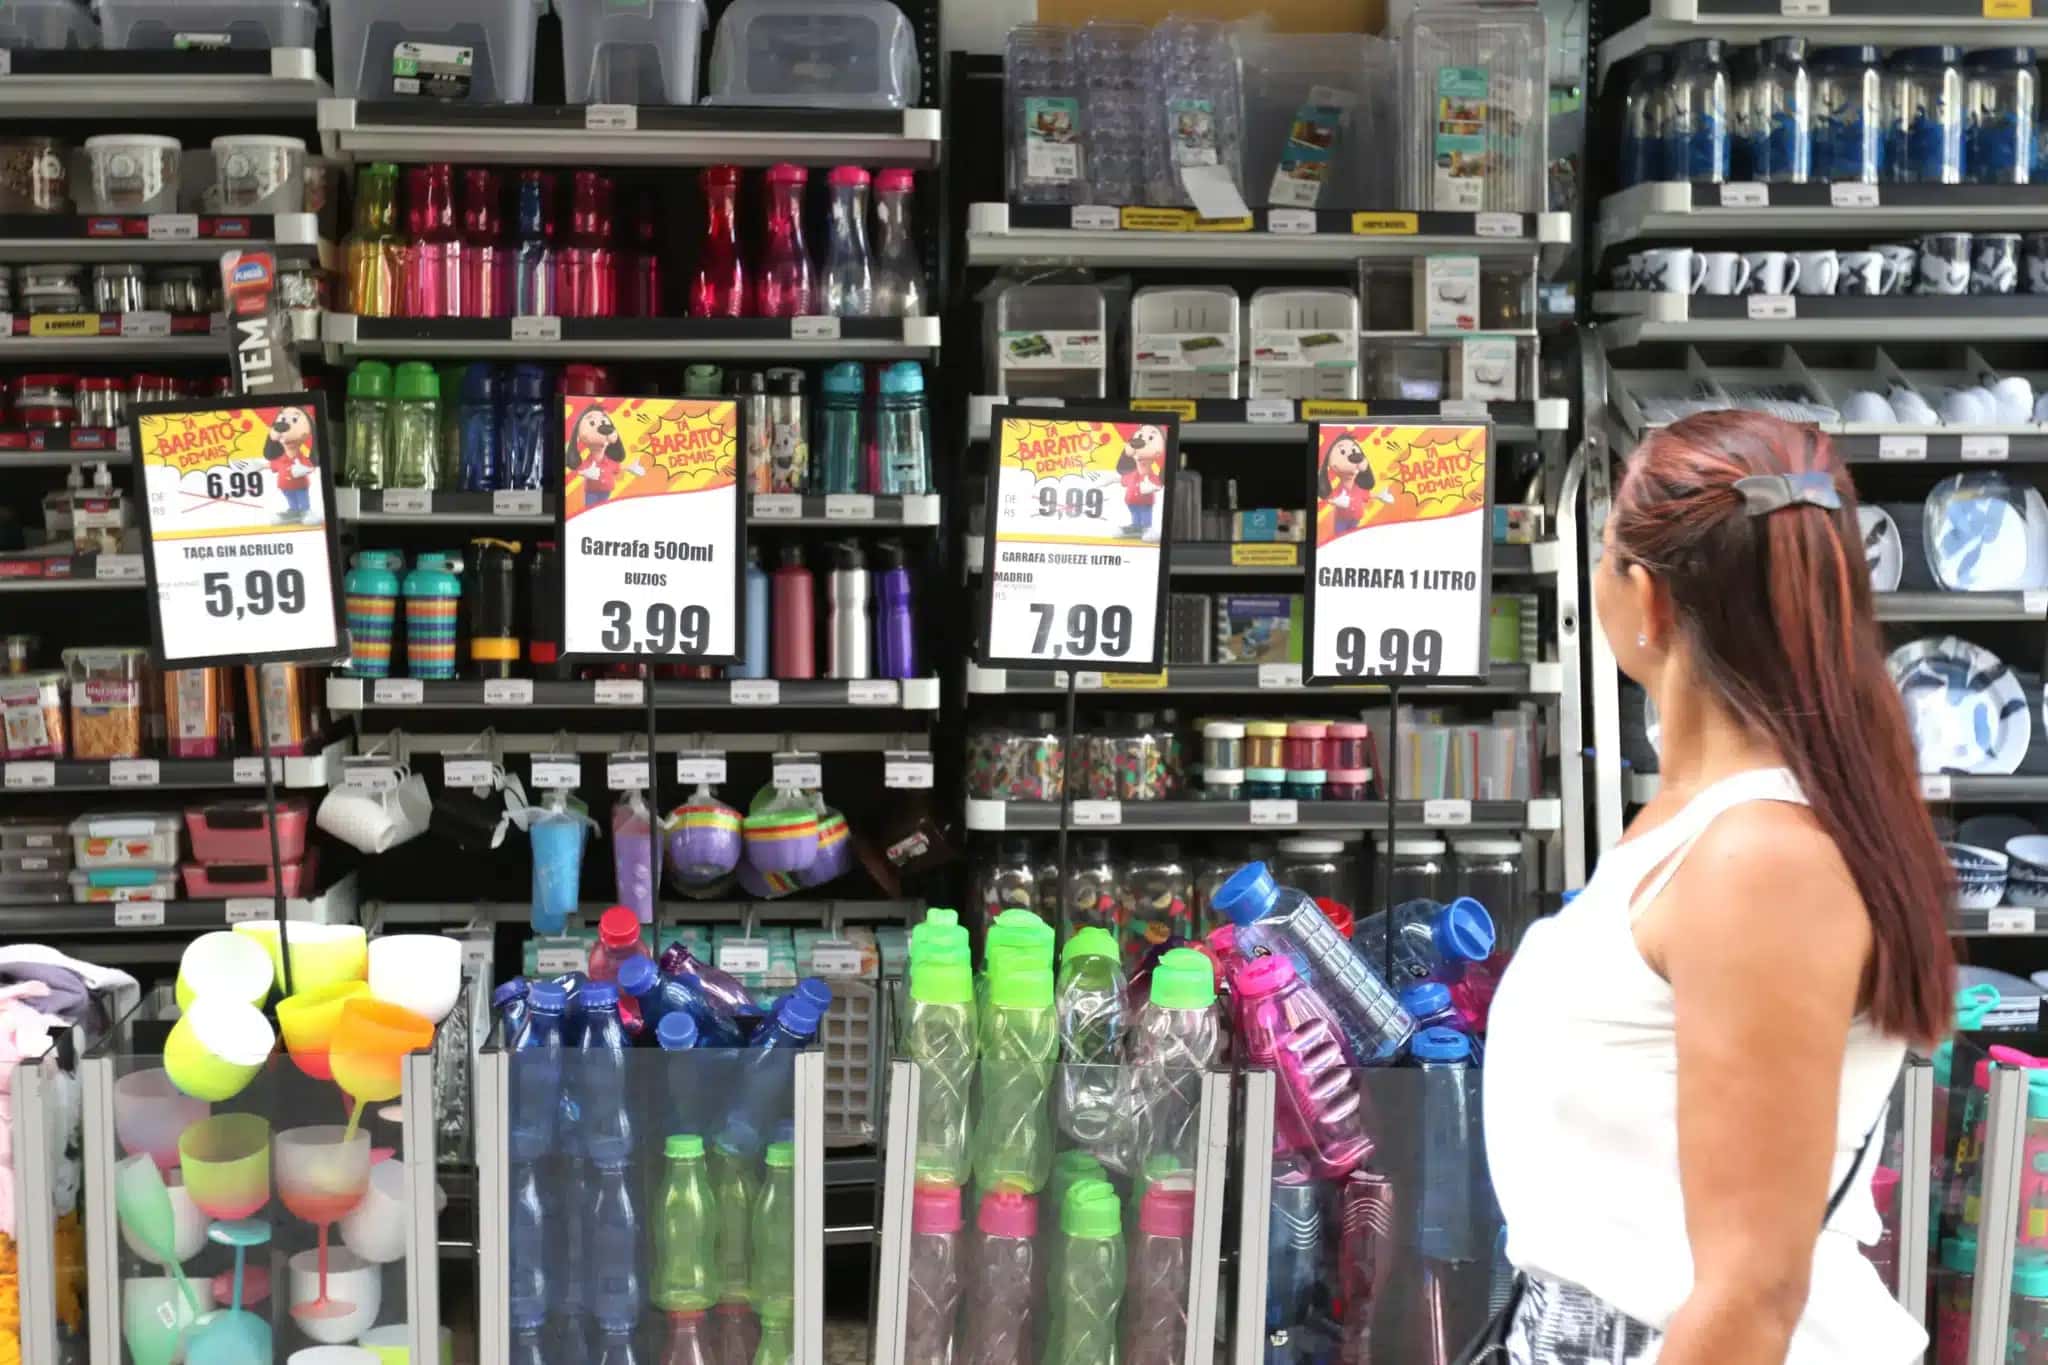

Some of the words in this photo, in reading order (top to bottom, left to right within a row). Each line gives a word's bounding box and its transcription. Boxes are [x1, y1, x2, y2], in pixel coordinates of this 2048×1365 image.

[237, 317, 274, 394] TEM
[158, 422, 235, 456] BARATO
[651, 428, 723, 456] BARATO
[1019, 432, 1092, 460] BARATO
[179, 445, 228, 467] DEMAIS
[668, 450, 715, 467] DEMAIS
[1036, 456, 1083, 472] DEMAIS
[1400, 453, 1471, 482] BARATO
[205, 471, 263, 501] 6,99
[1417, 475, 1463, 494] DEMAIS
[1038, 486, 1104, 520] 9,99
[217, 545, 237, 557] GIN
[239, 542, 294, 557] ACRILICO
[581, 536, 649, 559] Garrafa
[654, 541, 714, 562] 500ml
[1002, 551, 1046, 564] GARRAFA
[1048, 553, 1087, 565] SQUEEZE
[624, 571, 667, 587] BUZIOS
[994, 571, 1033, 583] MADRID
[1318, 566, 1405, 589] GARRAFA
[1410, 569, 1418, 589] 1
[1423, 570, 1476, 591] LITRO
[203, 568, 306, 620] 5,99
[1029, 603, 1133, 659] 7,99
